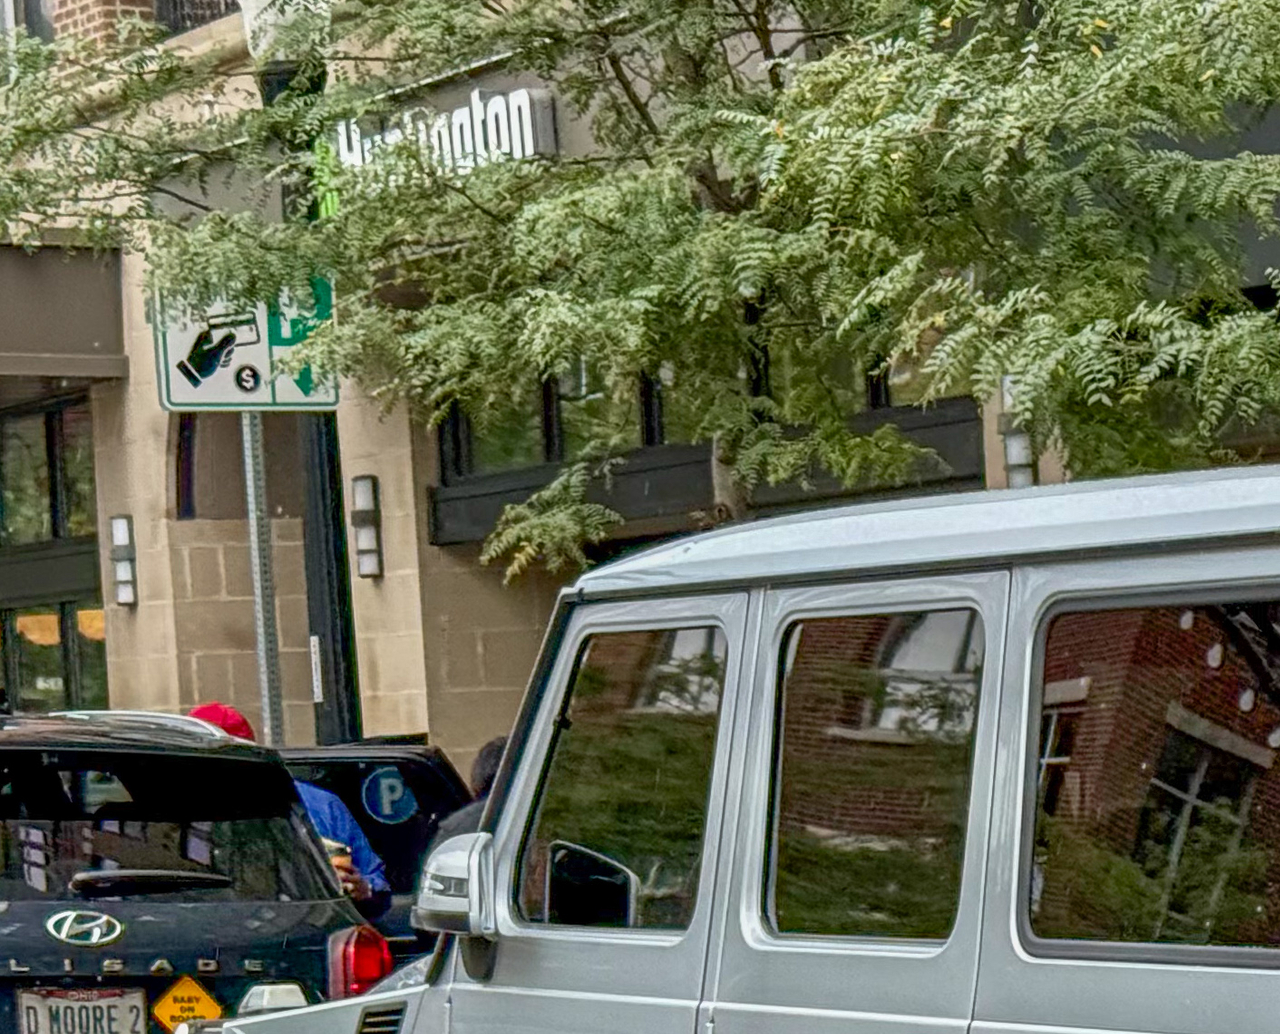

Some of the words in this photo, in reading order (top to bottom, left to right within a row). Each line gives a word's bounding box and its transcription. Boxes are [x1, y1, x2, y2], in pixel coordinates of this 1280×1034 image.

[380, 778, 404, 815] P
[172, 995, 201, 1004] BABY
[179, 1005, 195, 1013] ON
[25, 1005, 39, 1034] D
[129, 1005, 141, 1034] 2
